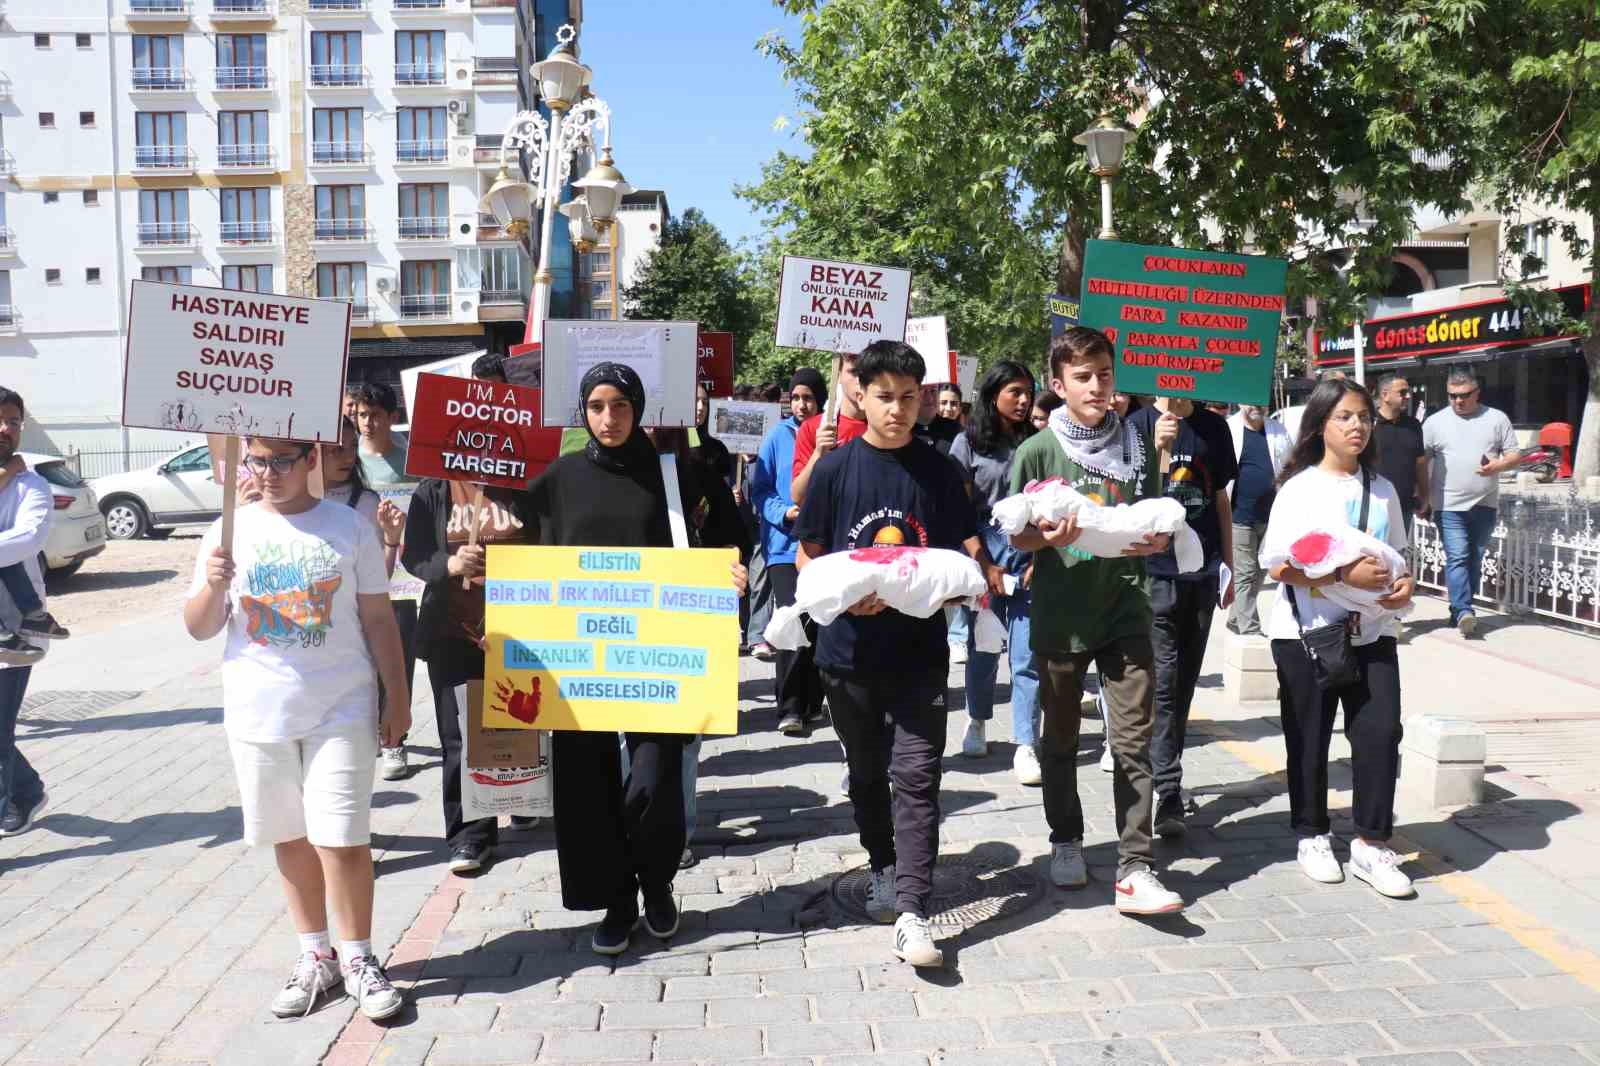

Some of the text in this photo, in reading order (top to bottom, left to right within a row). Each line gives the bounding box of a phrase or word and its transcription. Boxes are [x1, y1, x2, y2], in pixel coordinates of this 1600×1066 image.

[810, 265, 882, 289] BEYAZ
[801, 283, 888, 301] ÖNLÜKLERİMİZ
[171, 294, 310, 324] HASTANEYE
[811, 296, 874, 318] KANA
[1123, 306, 1164, 322] PARA
[193, 321, 284, 346] SALDIRI
[800, 315, 882, 333] BULANMASIN
[1128, 332, 1198, 349] PARAYLA
[200, 347, 275, 374] SAVAŞ
[176, 371, 293, 397] SUÇUDUR
[1159, 376, 1195, 390] SON!
[466, 384, 517, 405] I'M A
[446, 400, 532, 426] DOCTOR
[456, 430, 514, 453] NOT A
[442, 452, 526, 477] TARGET!
[579, 551, 641, 571] FİLİSTİN
[489, 584, 517, 602] BİR
[520, 585, 550, 603] DİN
[560, 586, 587, 600] IRK
[593, 585, 651, 604] MİLLET
[586, 615, 634, 634] DEĞİL
[512, 644, 704, 669] İNSANLIK VE VİCDAN
[569, 681, 676, 699] MESELESİDİR
